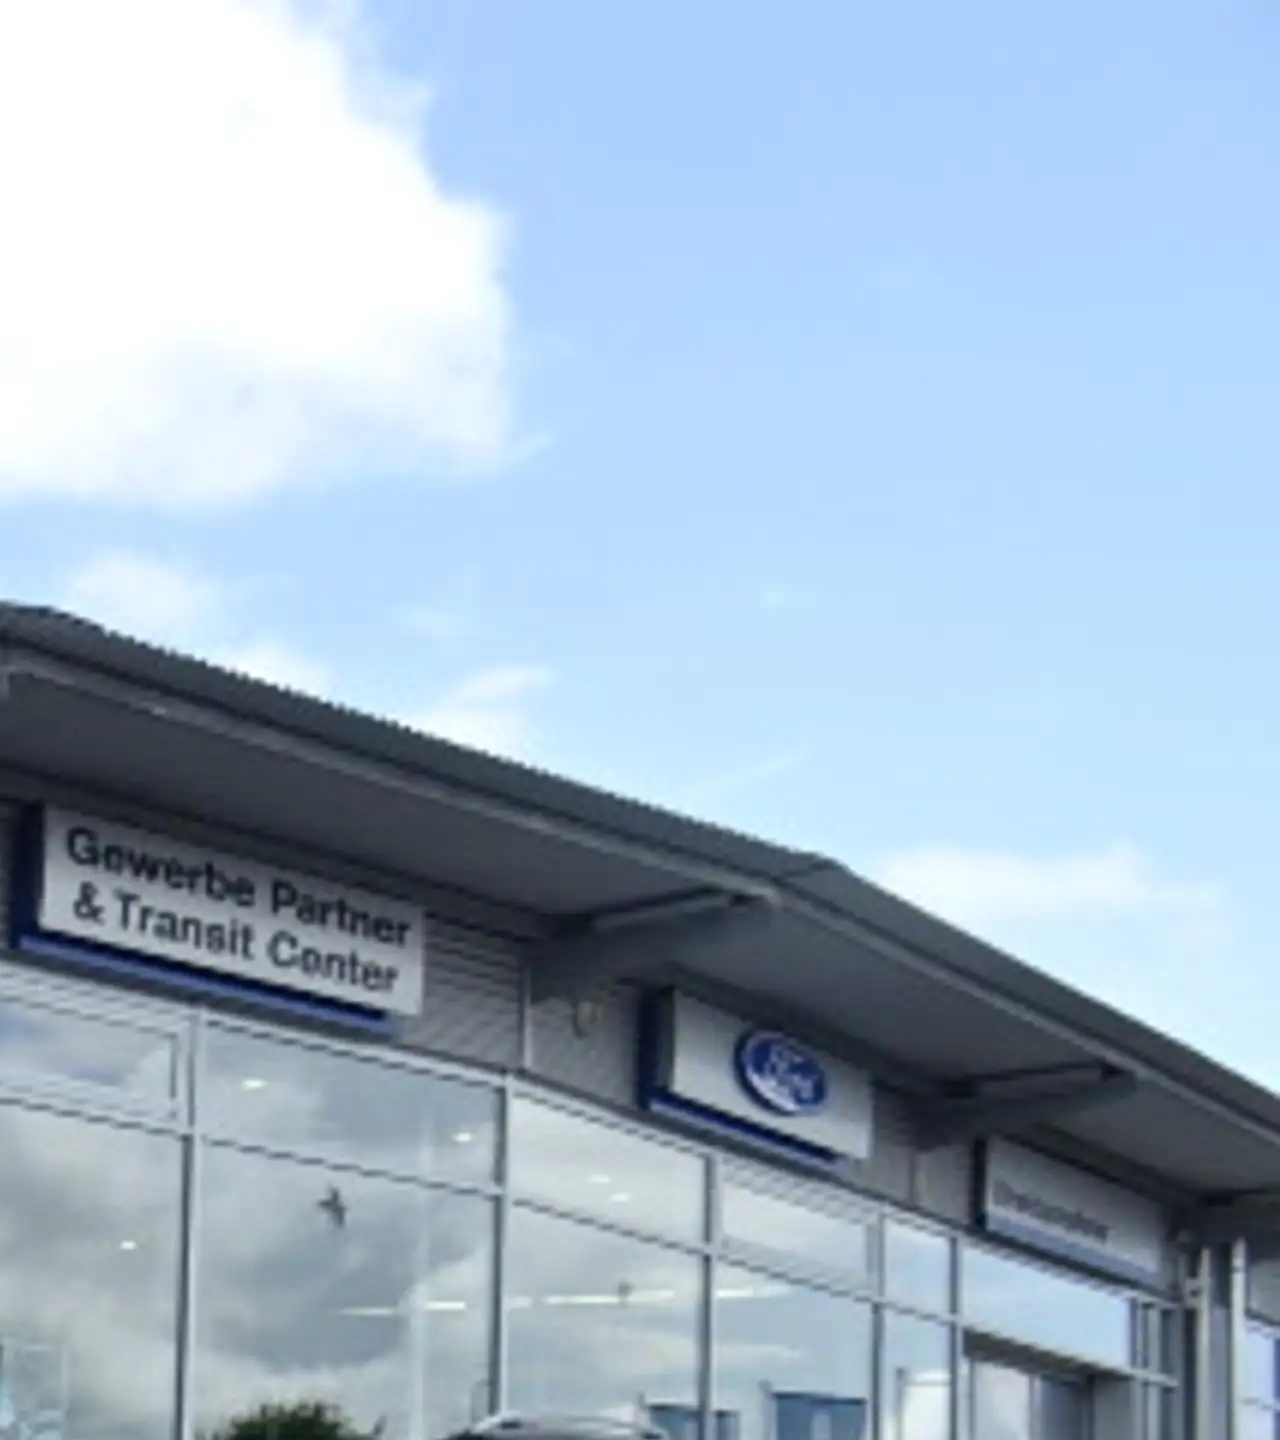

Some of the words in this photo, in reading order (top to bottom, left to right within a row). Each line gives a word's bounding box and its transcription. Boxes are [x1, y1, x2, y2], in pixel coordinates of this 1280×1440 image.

[65, 826, 258, 906] Gewerbe
[270, 879, 412, 949] Partner
[72, 882, 103, 923] &
[113, 889, 255, 960] Transit
[266, 930, 400, 992] Center
